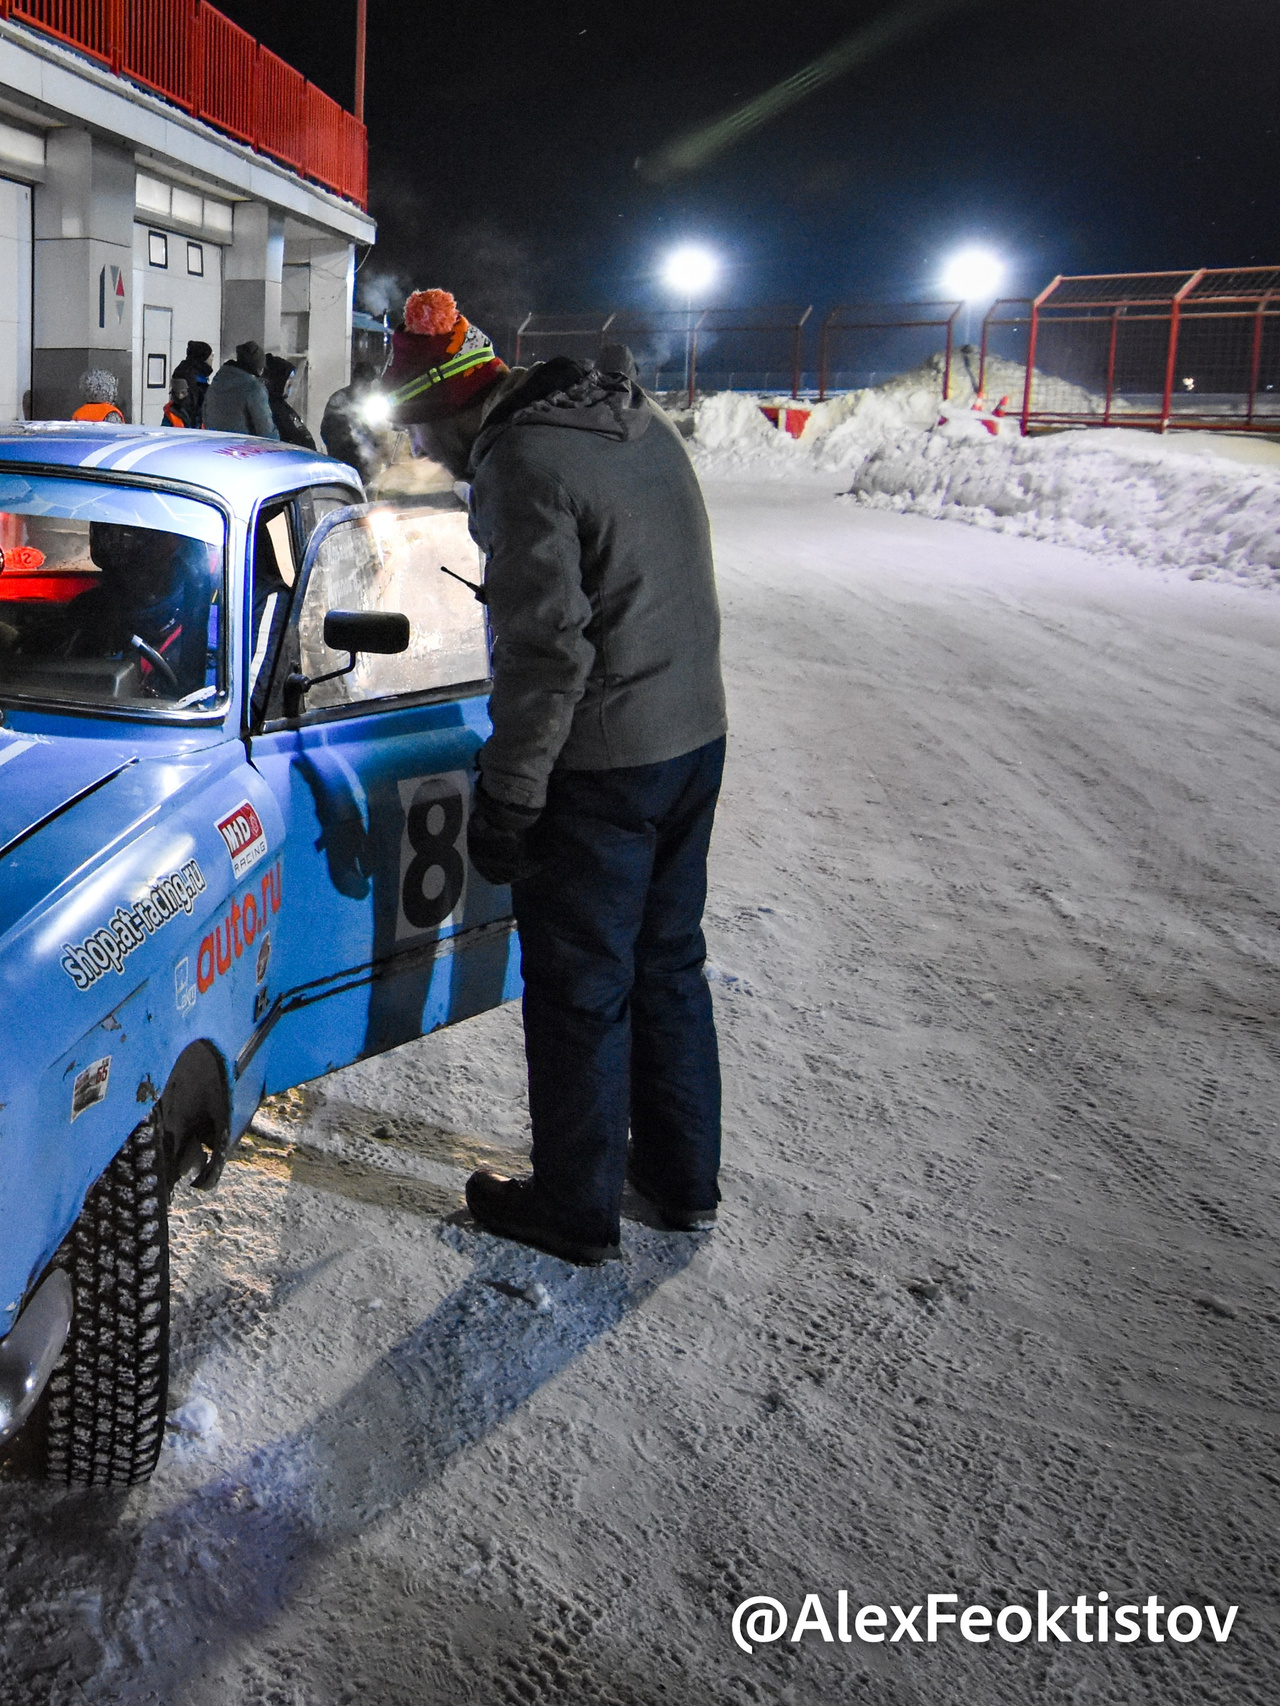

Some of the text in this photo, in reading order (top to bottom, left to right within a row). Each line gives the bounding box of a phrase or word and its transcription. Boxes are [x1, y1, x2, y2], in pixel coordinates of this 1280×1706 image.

[233, 840, 266, 872] RACING
[402, 778, 465, 929] 8
[61, 858, 206, 990] shop.at-racing.ru
[197, 861, 282, 994] auto.ru
